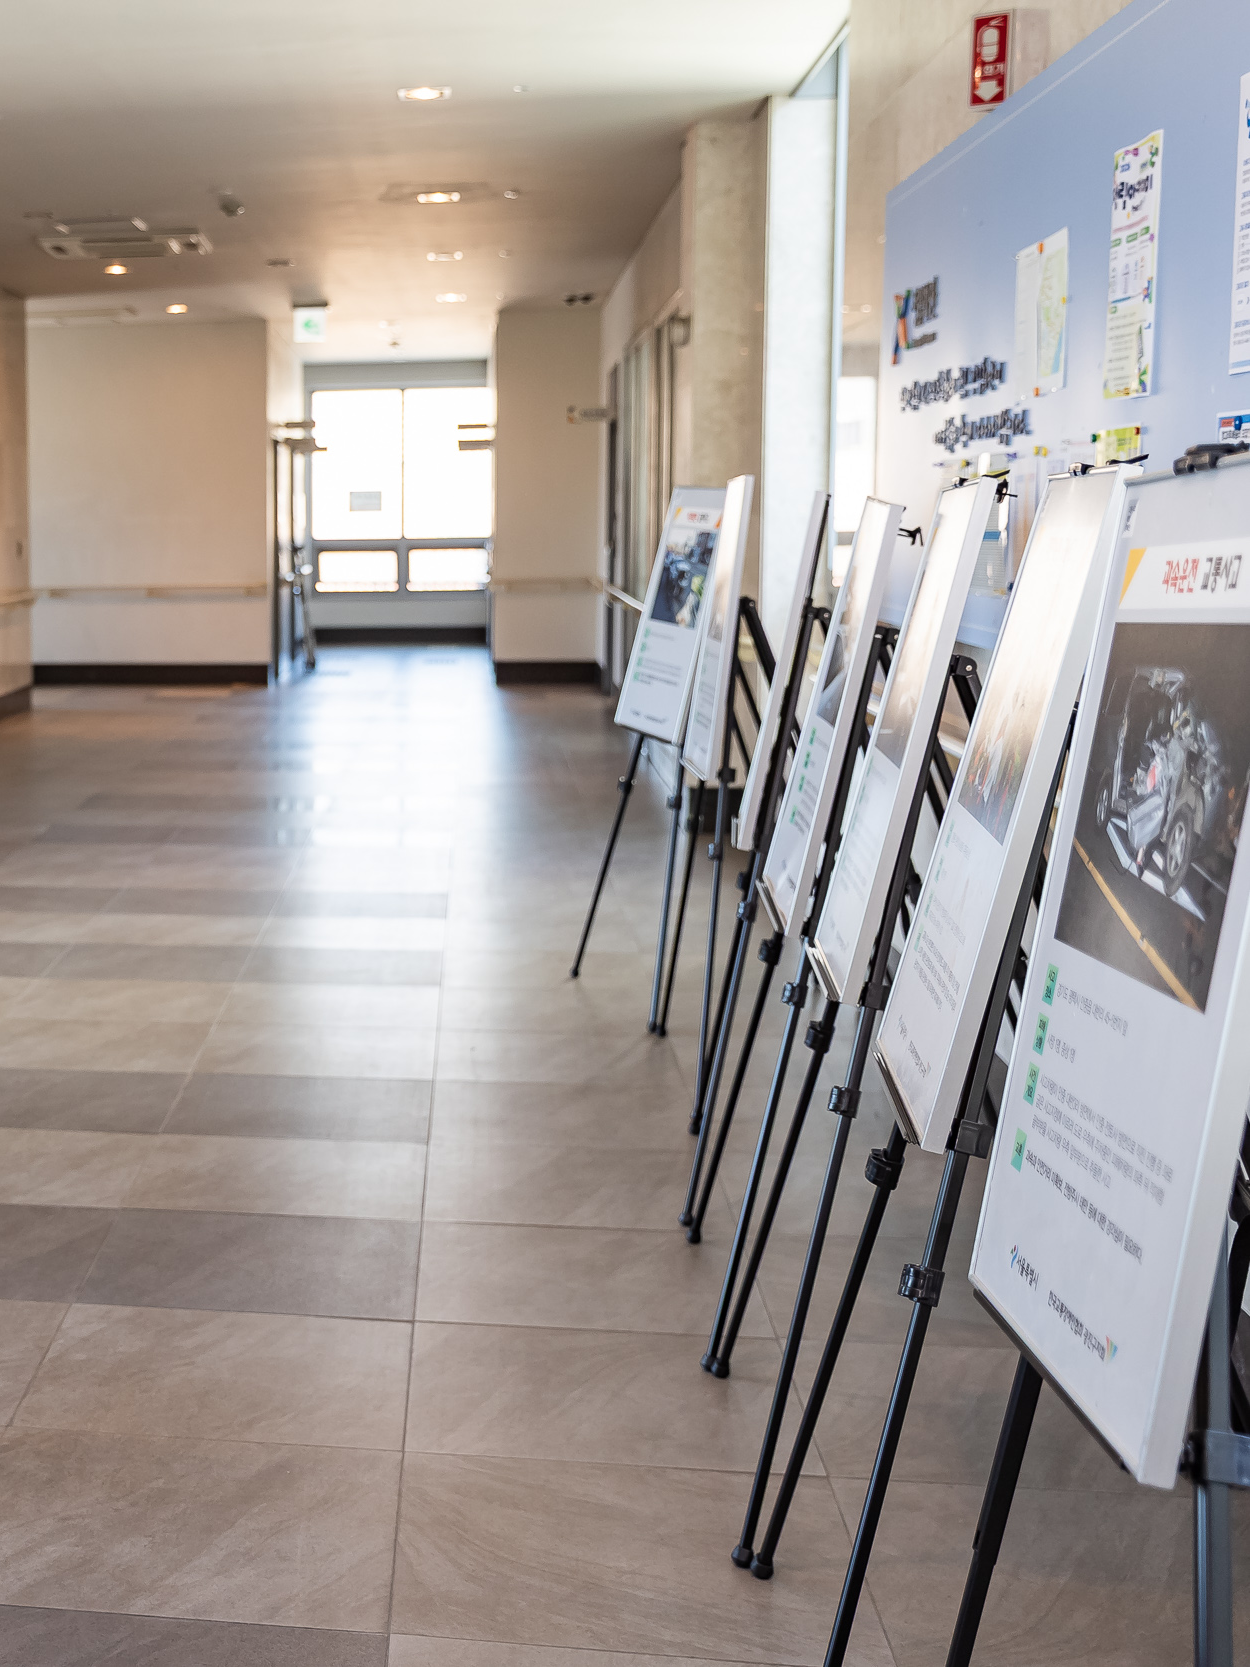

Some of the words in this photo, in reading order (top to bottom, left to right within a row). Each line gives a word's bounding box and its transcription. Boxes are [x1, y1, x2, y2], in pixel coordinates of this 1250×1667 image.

[1159, 557, 1200, 593] 과속운전
[1199, 555, 1242, 593] 교통사고
[1056, 982, 1068, 1002] 경기도
[1024, 1147, 1037, 1170] 과속과
[1015, 1252, 1039, 1292] 서울특별시
